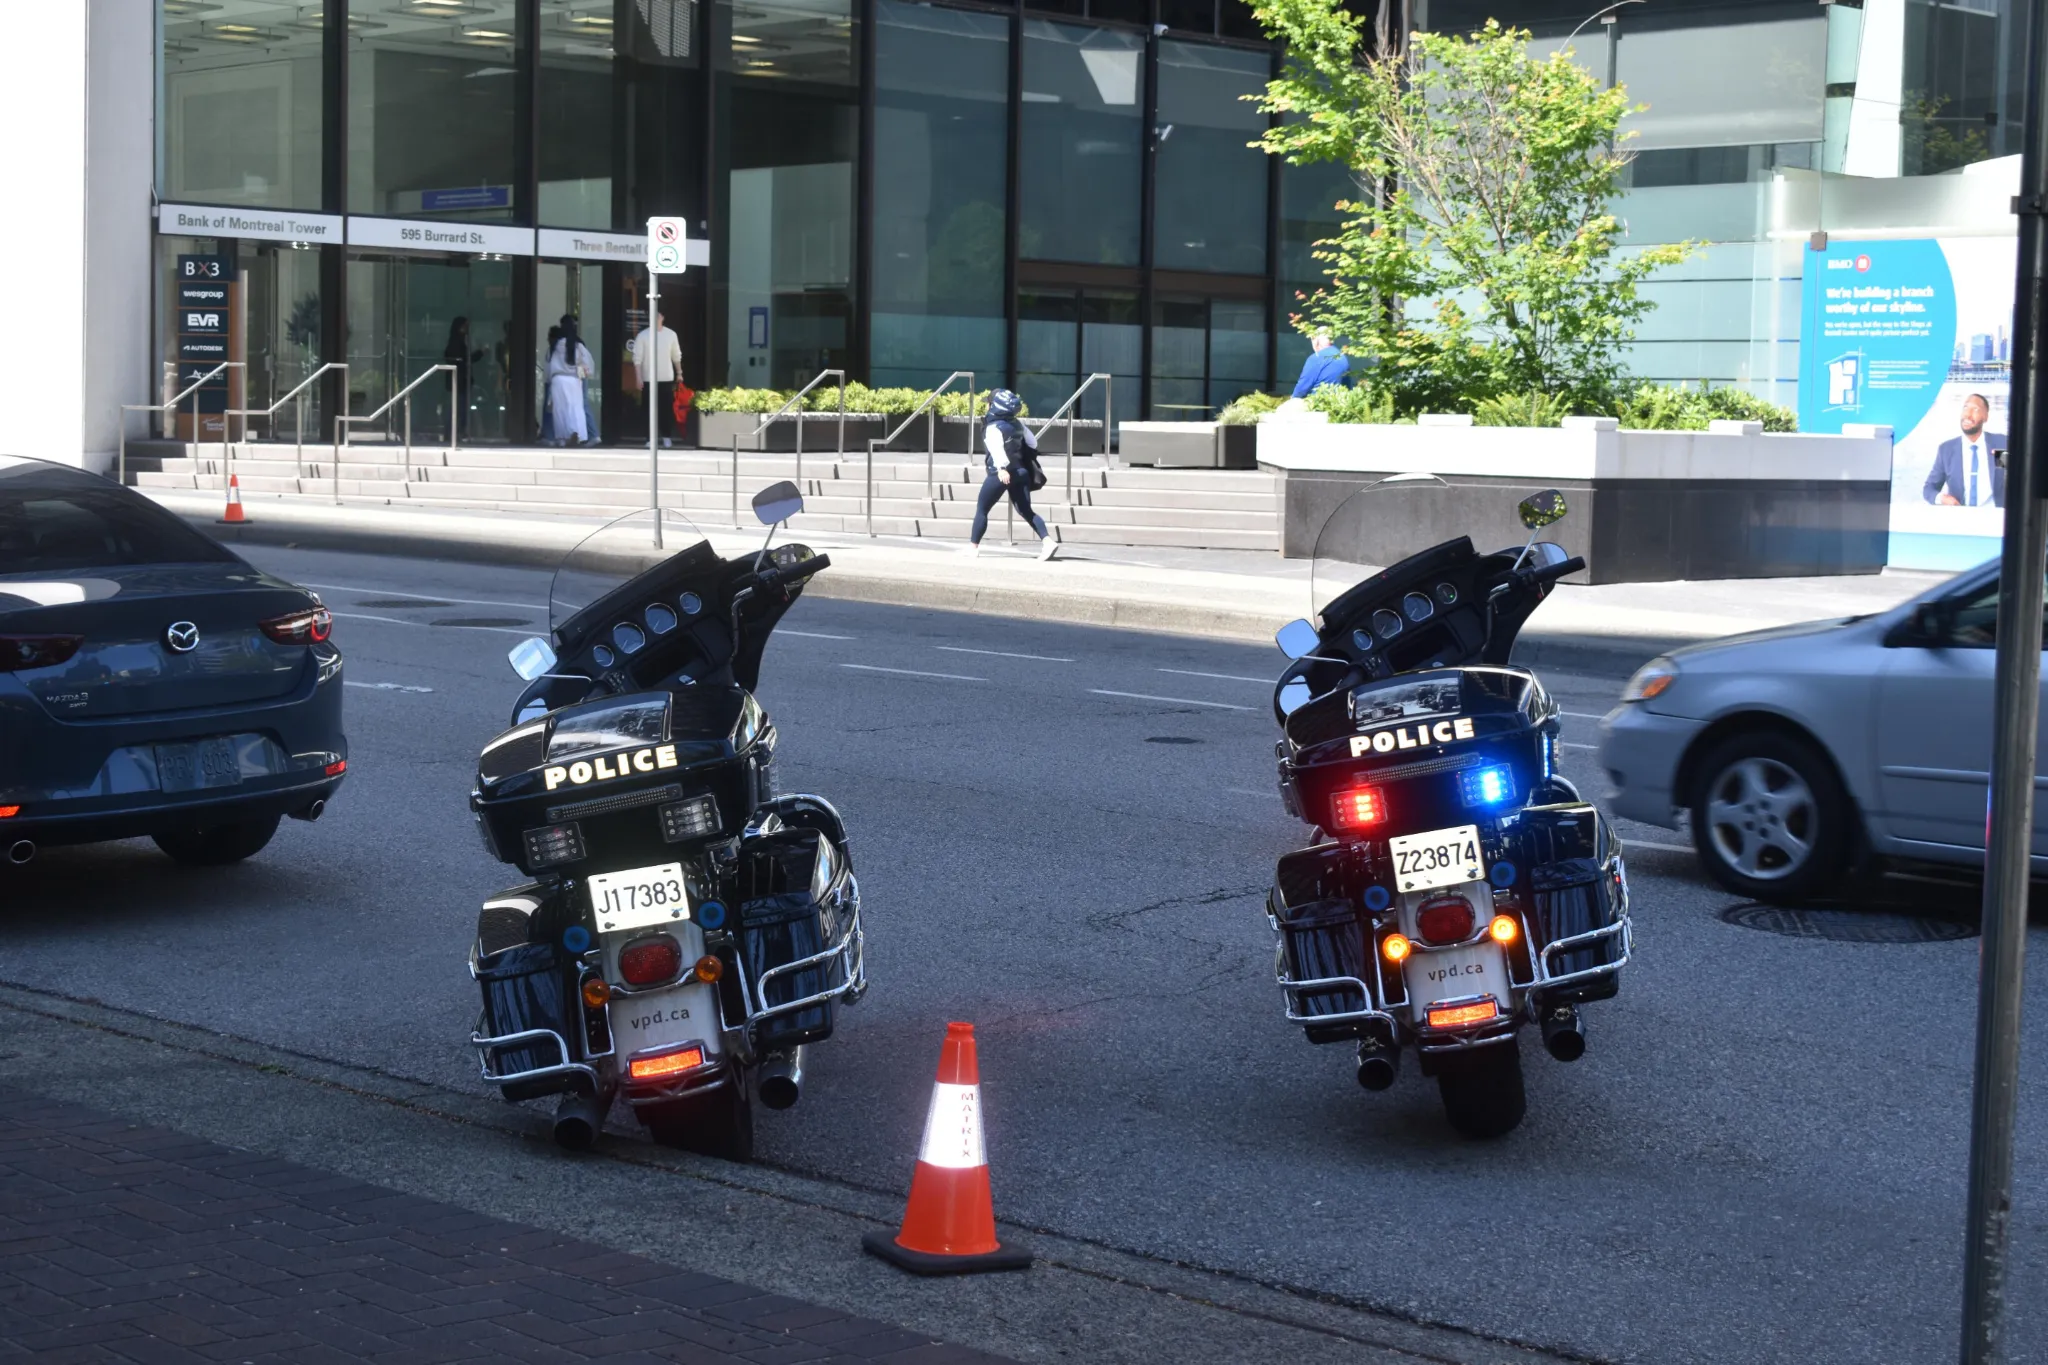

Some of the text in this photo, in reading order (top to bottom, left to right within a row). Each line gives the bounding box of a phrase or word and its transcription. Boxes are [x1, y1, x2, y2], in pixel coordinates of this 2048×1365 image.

[177, 213, 327, 235] Bank of Montreal Tower
[401, 228, 486, 245] 595 Burrard St.
[572, 239, 603, 253] Three
[605, 241, 642, 255] Bentall
[183, 290, 224, 299] wesgroup
[1853, 286, 1892, 300] building
[1893, 288, 1900, 298] a
[1901, 285, 1934, 298] branch
[1825, 301, 1859, 315] worthy
[1859, 301, 1871, 313] of
[1871, 304, 1888, 313] our
[187, 313, 219, 327] EVR
[1350, 717, 1475, 758] POLICE
[544, 745, 678, 790] POLICE
[1396, 840, 1478, 875] Z23874
[598, 879, 682, 914] J17383
[1428, 961, 1484, 982] vpd.ca
[631, 1008, 690, 1030] vpd.ca
[961, 1092, 974, 1158] MATRIX
